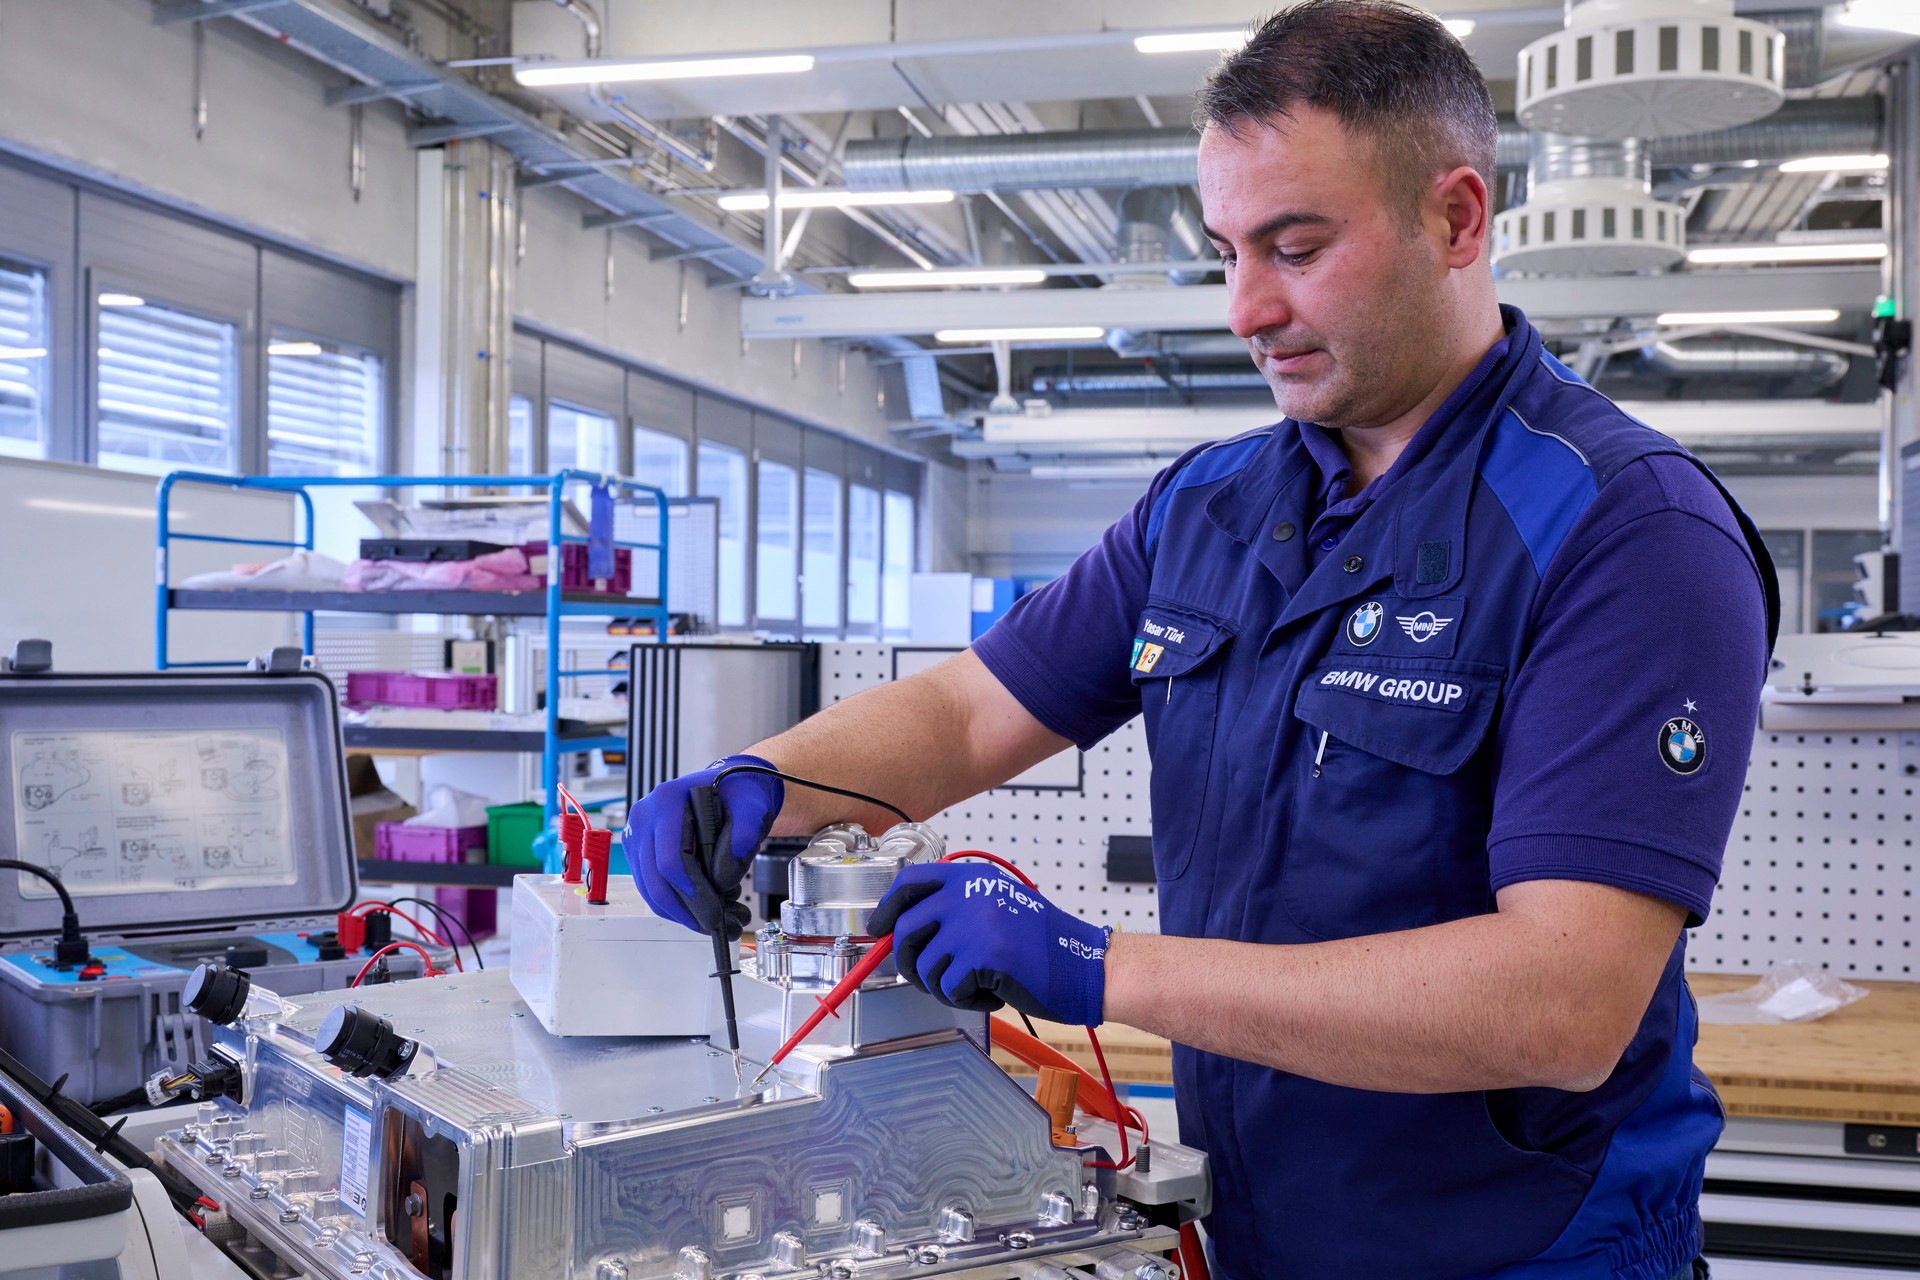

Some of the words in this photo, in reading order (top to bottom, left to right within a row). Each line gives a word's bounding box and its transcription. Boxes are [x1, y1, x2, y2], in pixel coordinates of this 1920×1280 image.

[1143, 618, 1165, 637] Yasar
[1163, 625, 1185, 644] Türk
[1413, 621, 1434, 632] MINI
[1147, 653, 1156, 663] 3
[1320, 671, 1379, 692] BMW
[1378, 678, 1463, 705] GROUP
[1668, 720, 1704, 743] BMW
[1059, 937, 1068, 948] 8
